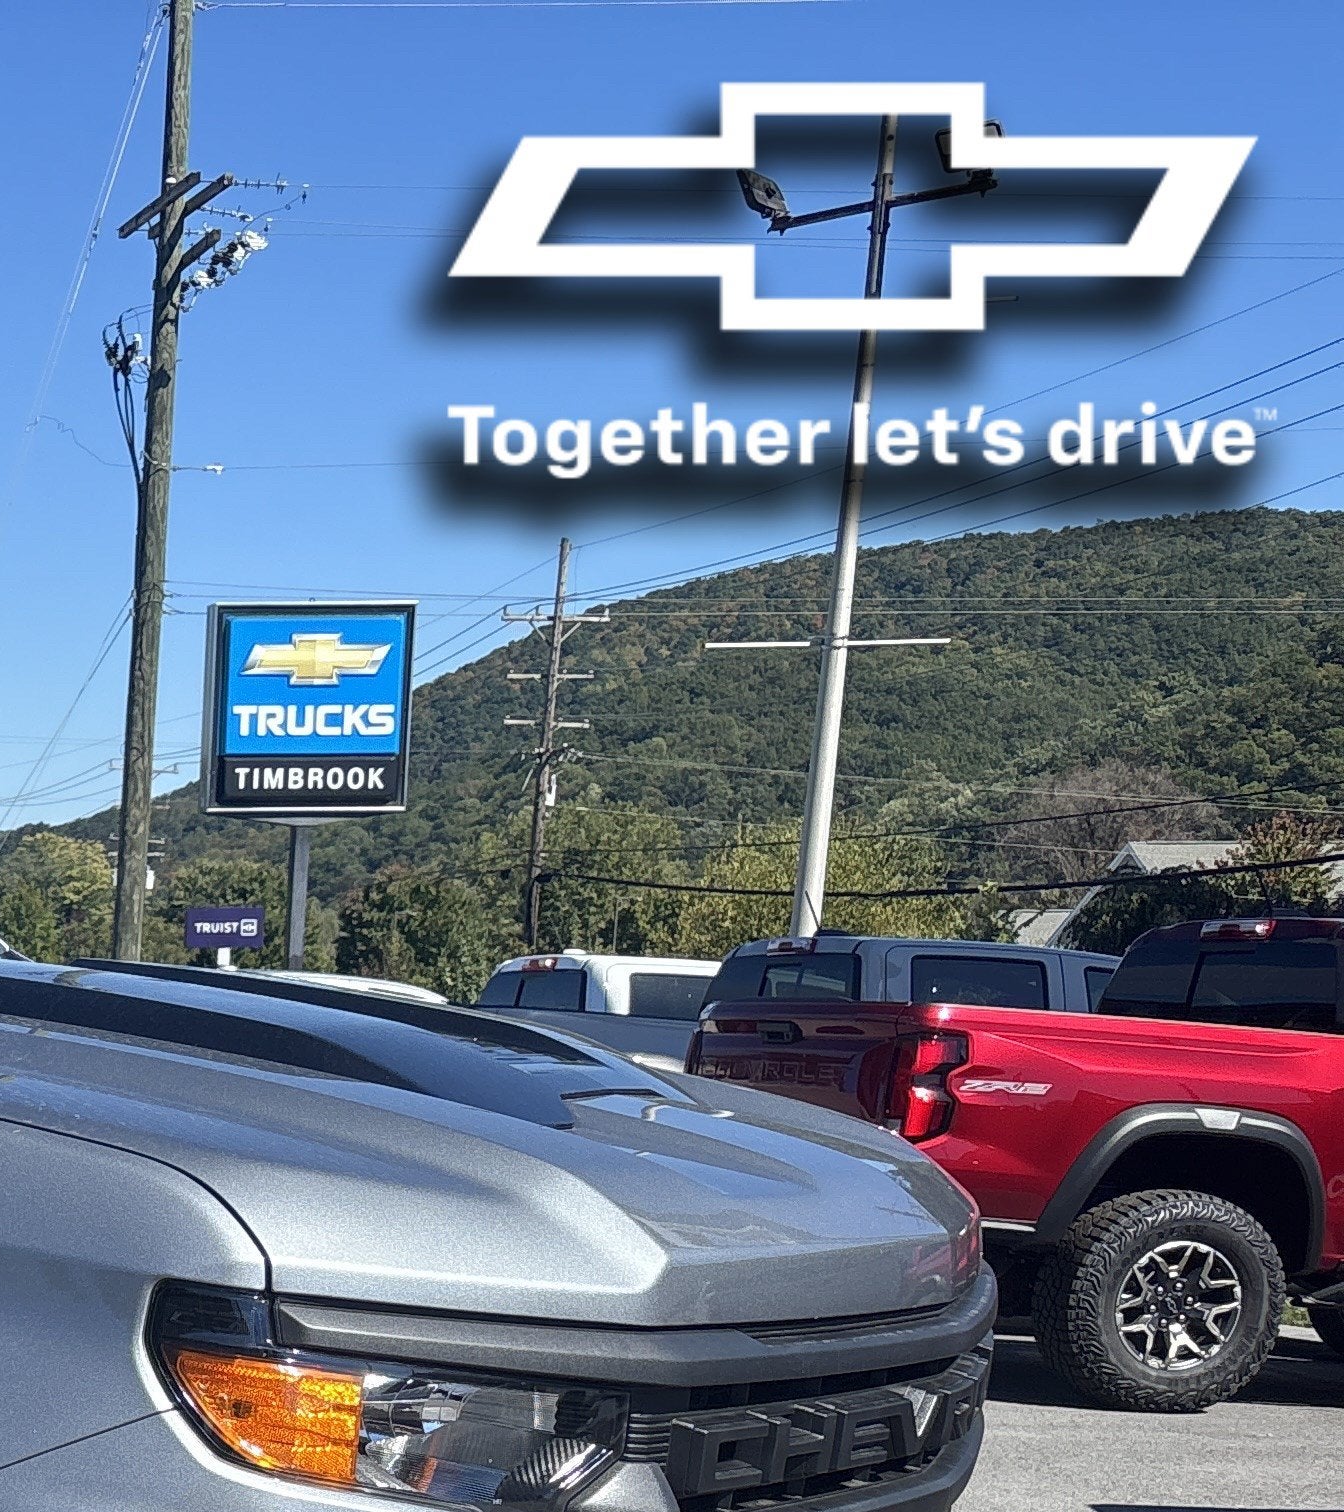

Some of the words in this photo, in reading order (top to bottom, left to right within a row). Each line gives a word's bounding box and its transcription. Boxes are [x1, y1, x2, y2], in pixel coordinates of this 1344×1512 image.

[233, 703, 395, 736] TRUCKS
[234, 767, 385, 790] TIMBROOK
[194, 921, 239, 934] TRUIST
